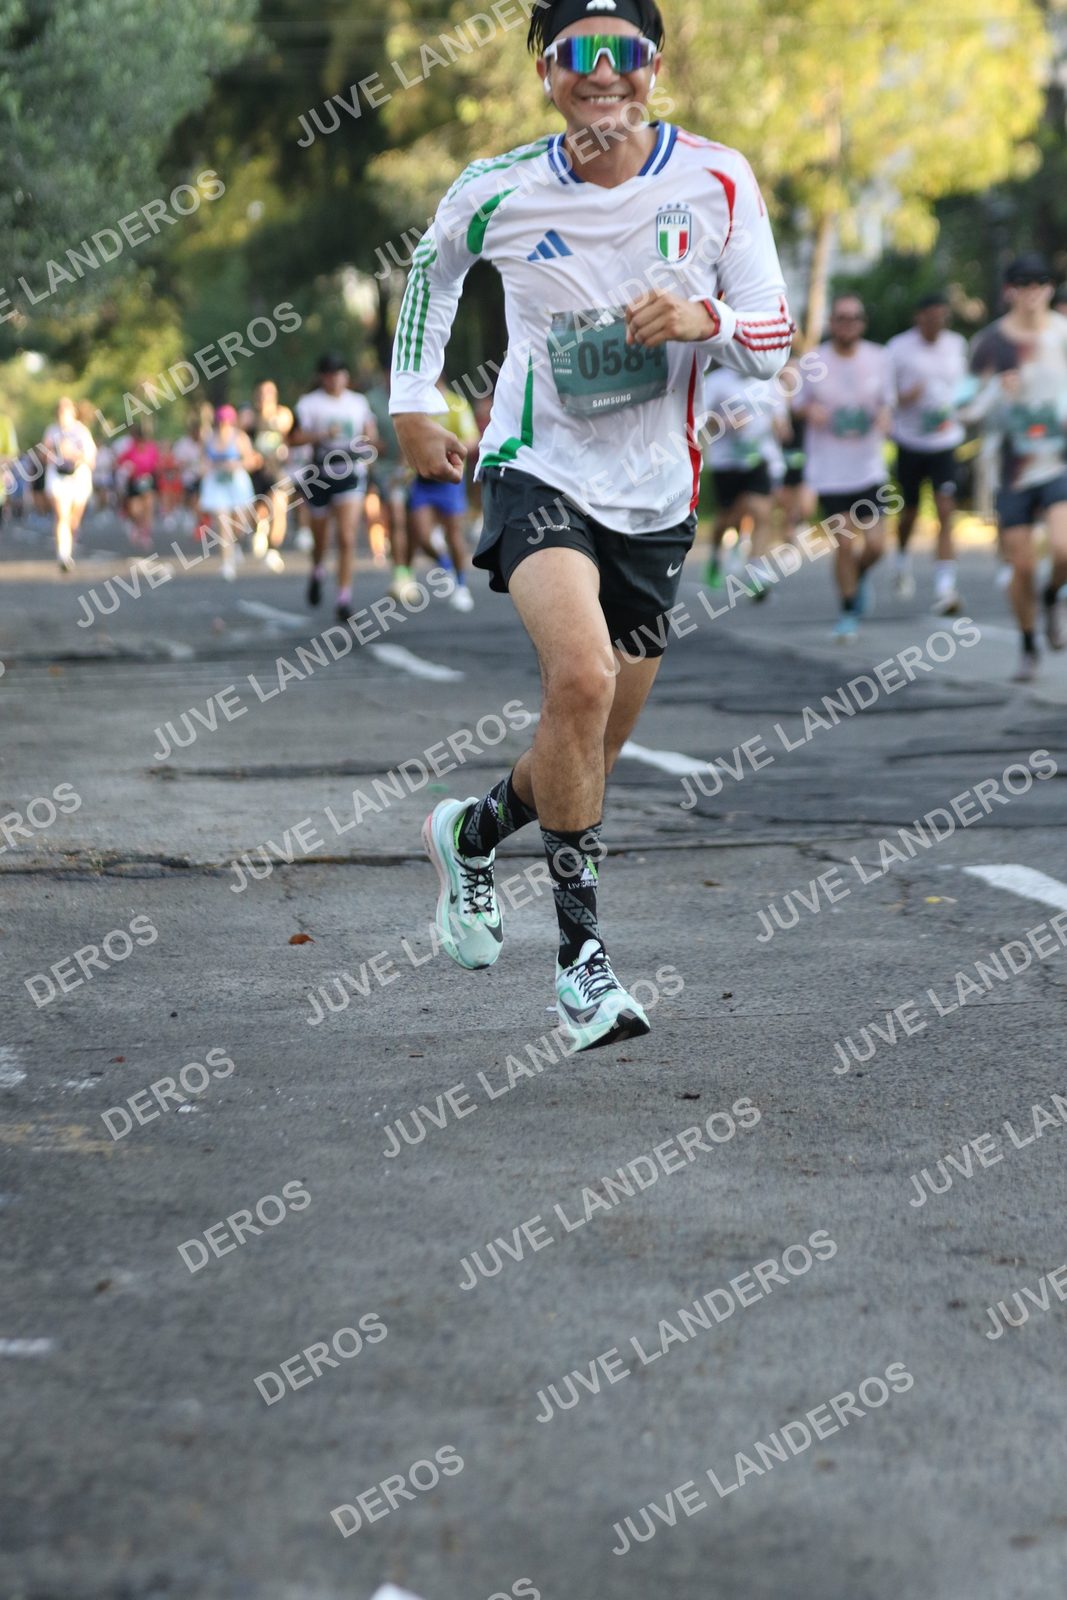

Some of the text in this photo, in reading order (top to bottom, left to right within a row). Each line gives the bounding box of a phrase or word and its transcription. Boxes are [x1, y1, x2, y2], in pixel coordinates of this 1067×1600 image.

[659, 215, 688, 224] ITALIA
[578, 338, 664, 380] 0584
[592, 394, 631, 407] SAMSUNG
